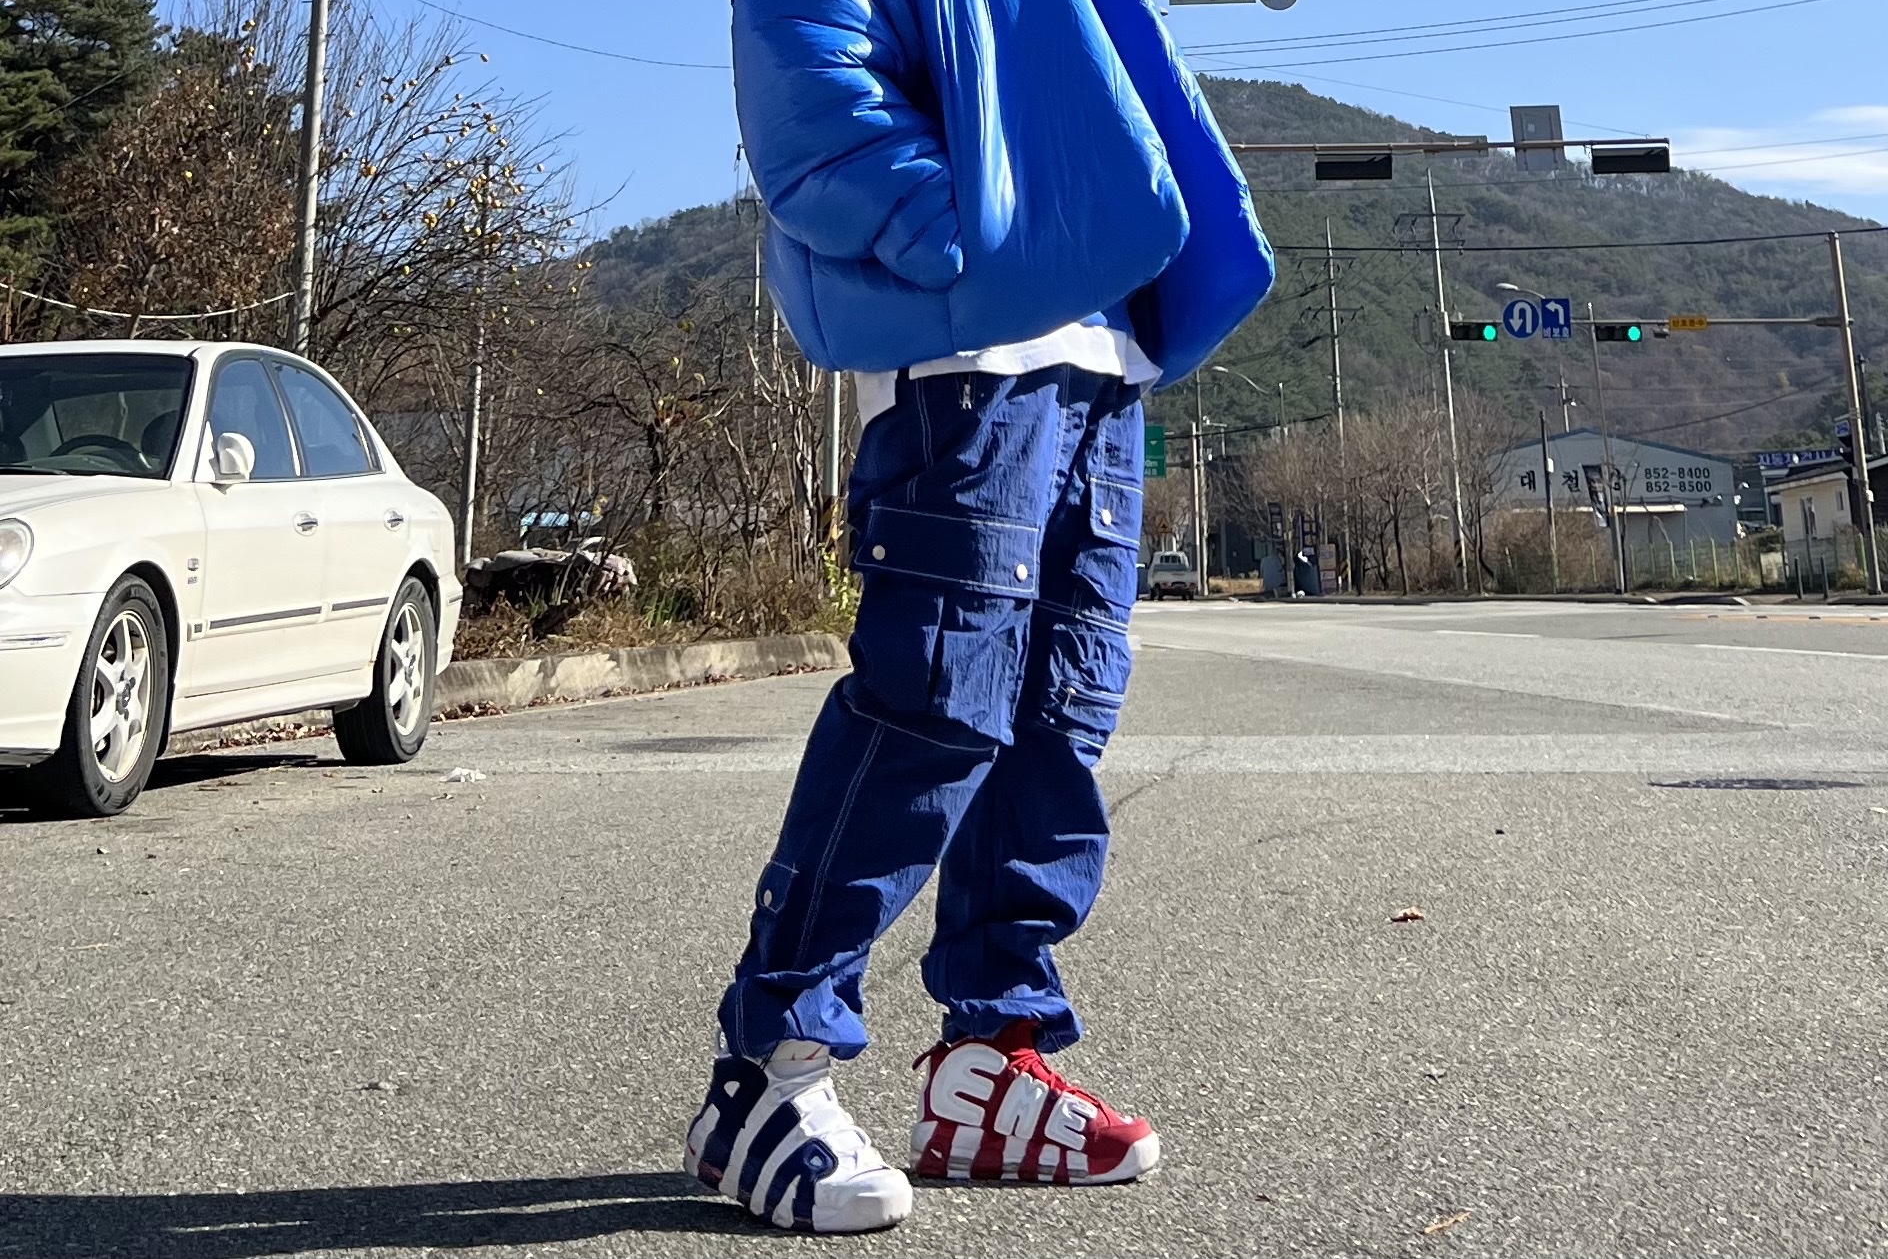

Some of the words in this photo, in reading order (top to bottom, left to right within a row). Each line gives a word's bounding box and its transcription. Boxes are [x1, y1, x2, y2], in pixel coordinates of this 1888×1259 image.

[1542, 326, 1570, 338] 비보호
[1644, 467, 1711, 480] 852-8400
[1645, 480, 1712, 493] 852-8500
[929, 1042, 1098, 1152] EME
